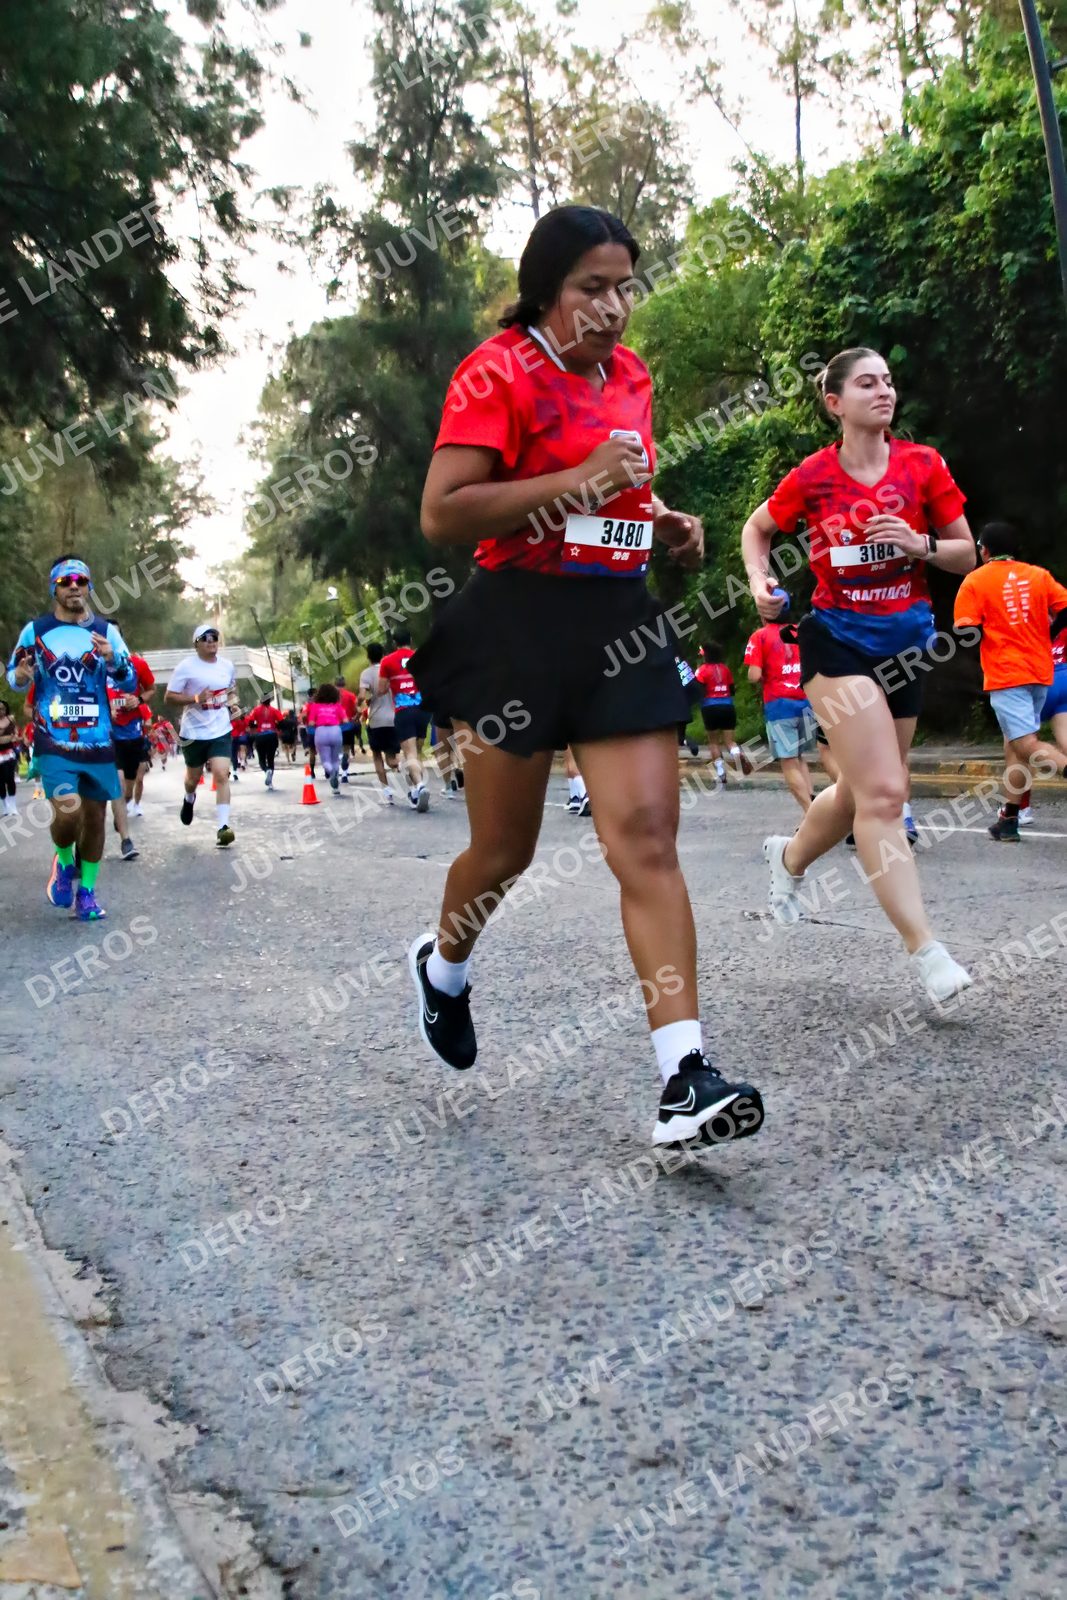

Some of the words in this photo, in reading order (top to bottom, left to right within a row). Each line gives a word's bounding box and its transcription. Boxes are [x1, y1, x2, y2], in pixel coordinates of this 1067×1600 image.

[601, 520, 645, 548] 3480
[859, 543, 895, 563] 3184
[55, 666, 85, 683] OV
[63, 705, 84, 716] 3881
